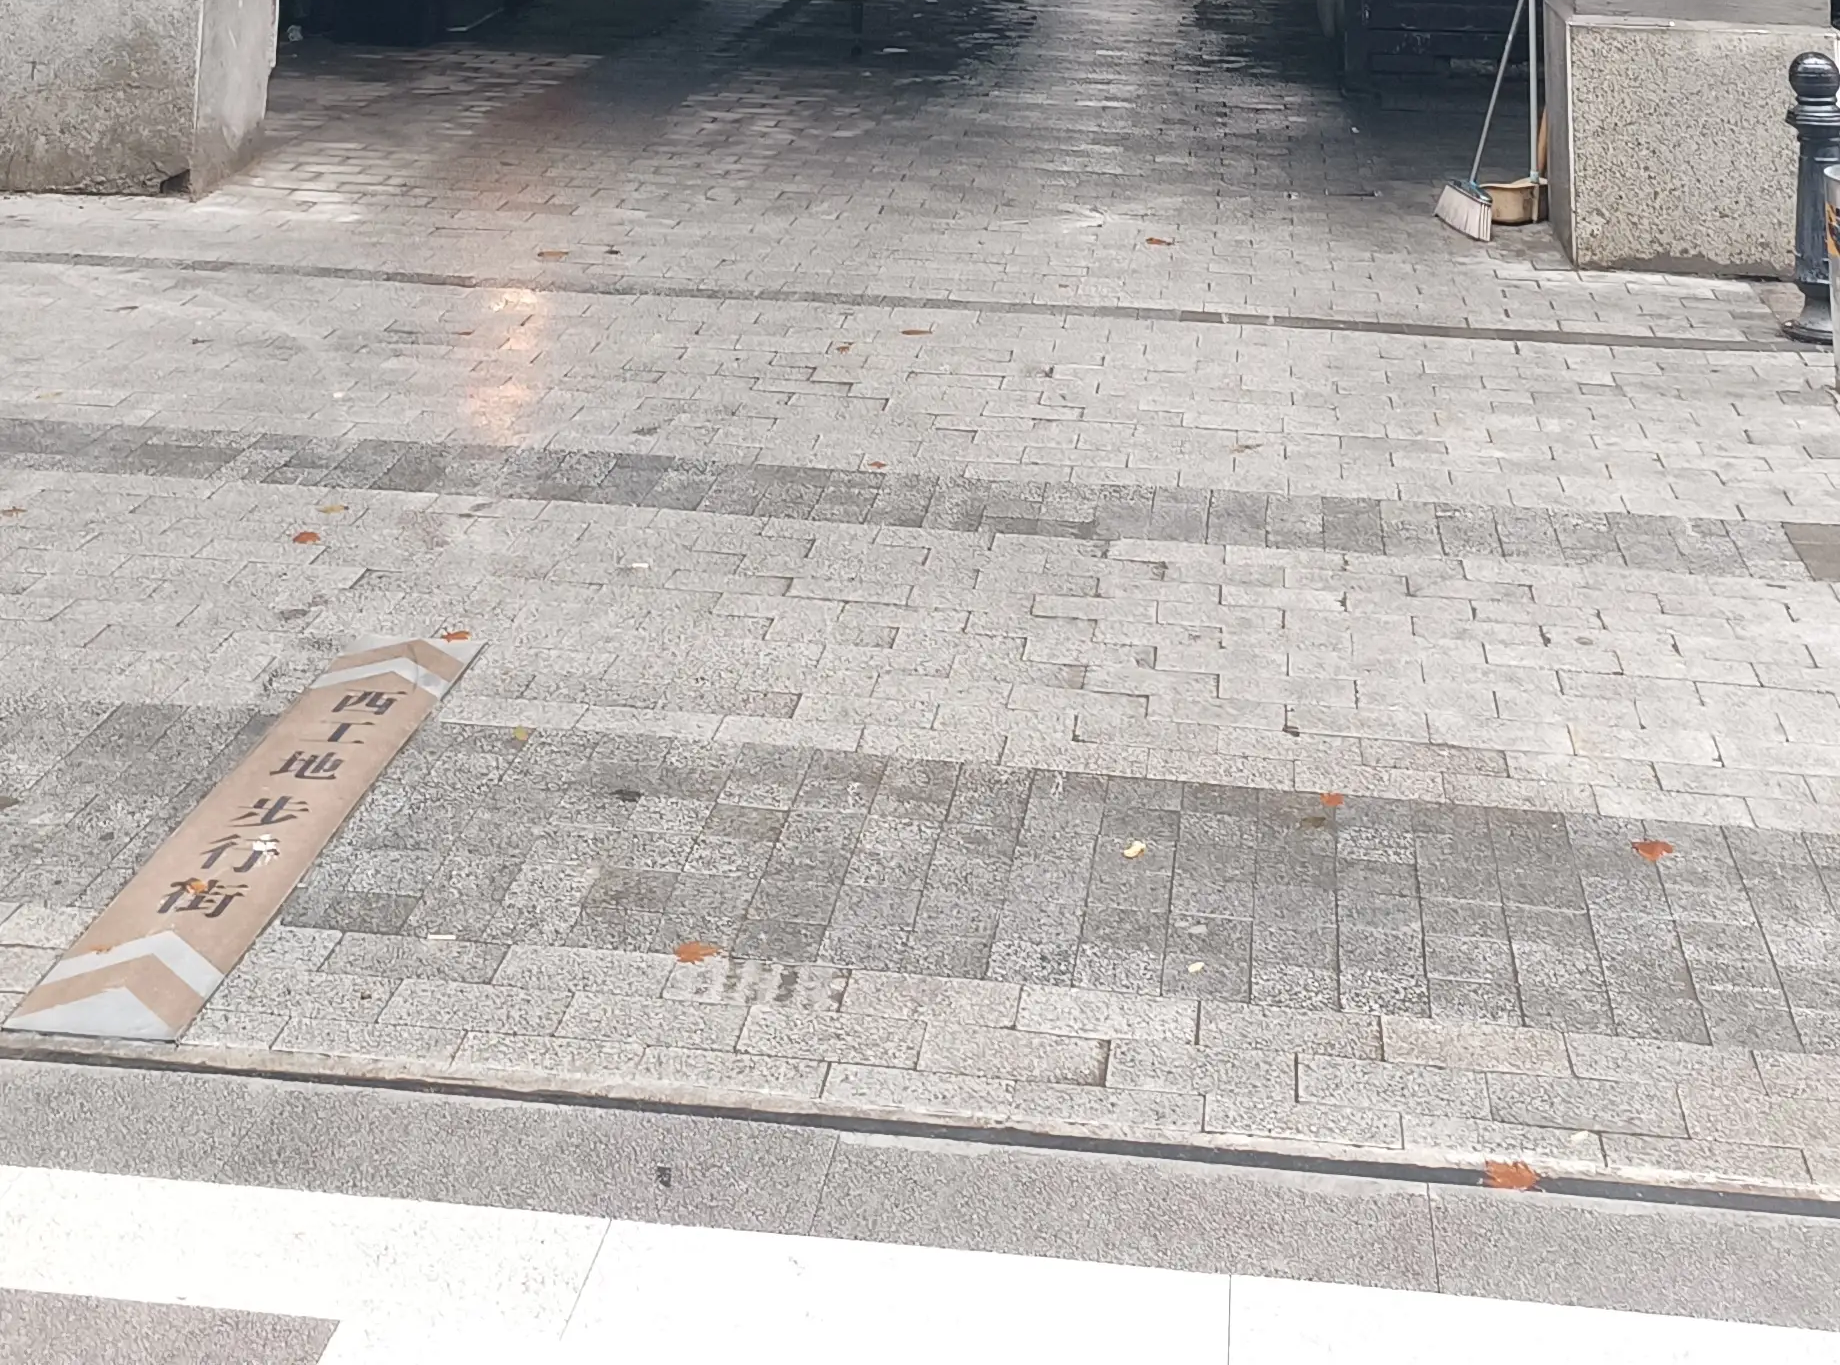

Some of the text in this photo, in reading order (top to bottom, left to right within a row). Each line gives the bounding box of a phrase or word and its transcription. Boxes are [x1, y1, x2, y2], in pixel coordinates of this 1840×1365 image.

[157, 689, 406, 919] 西工地步行街
